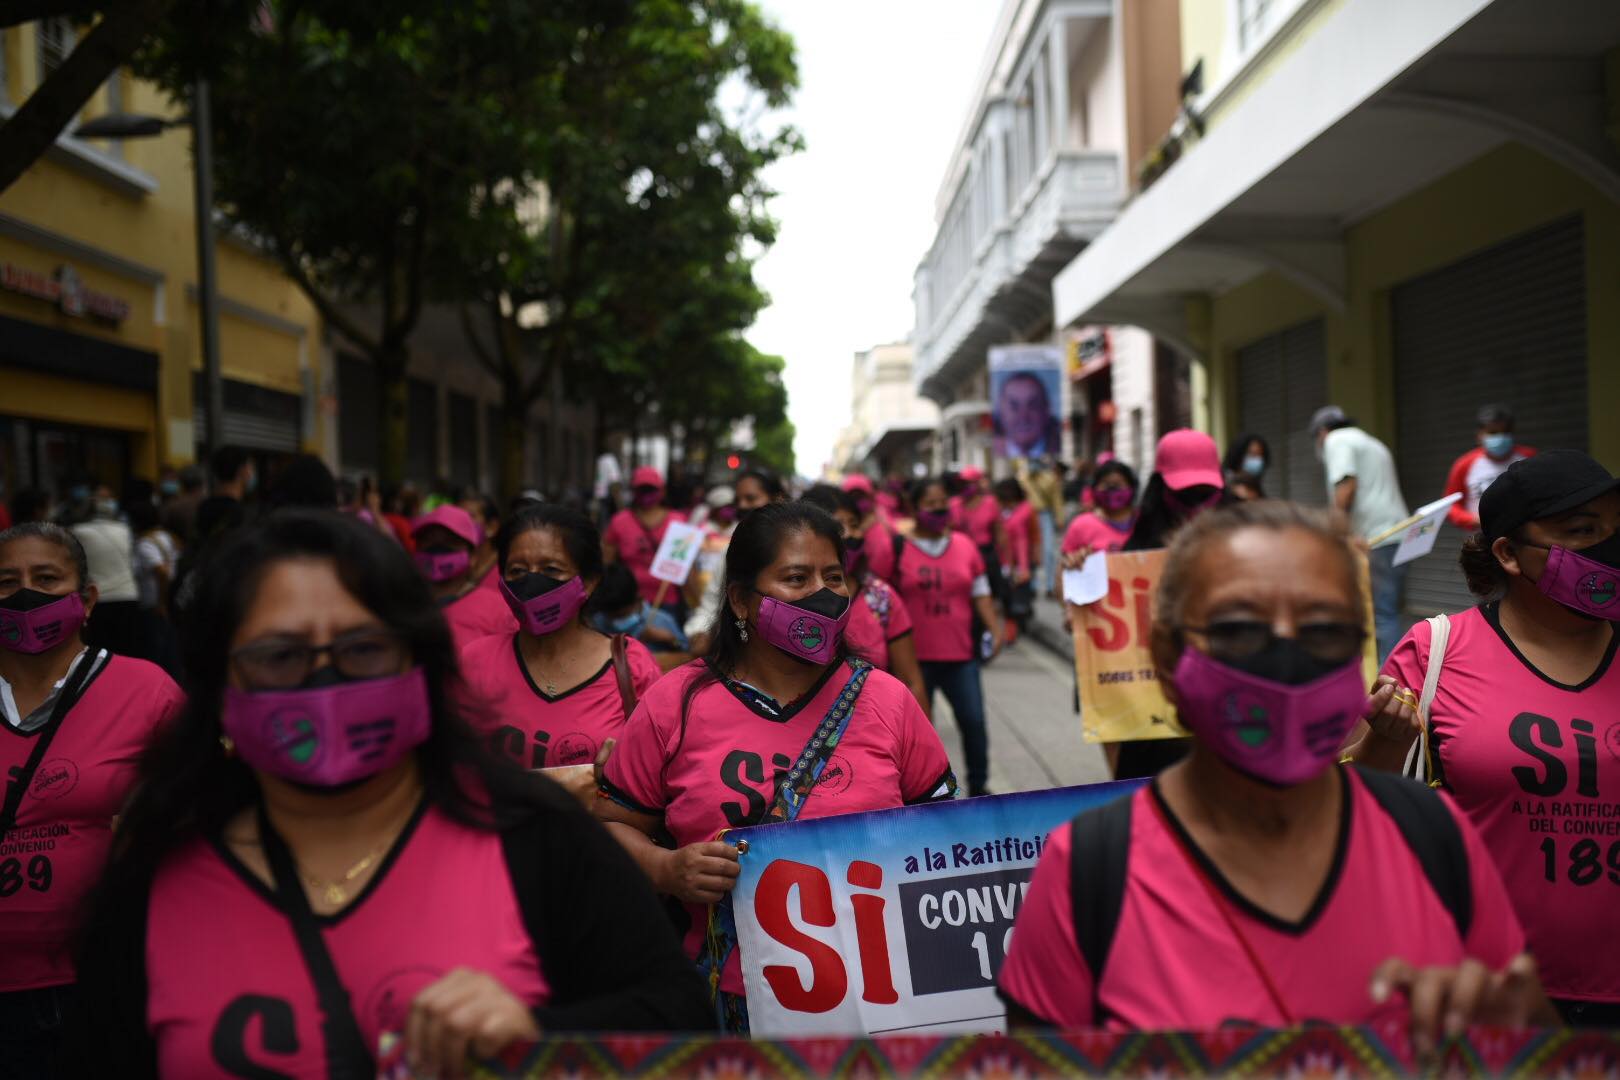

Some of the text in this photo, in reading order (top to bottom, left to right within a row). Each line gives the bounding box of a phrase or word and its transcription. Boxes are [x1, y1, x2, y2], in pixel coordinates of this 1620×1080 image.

[1088, 577, 1150, 653] Si
[1508, 711, 1599, 798] Si
[1511, 801, 1522, 814] A
[1527, 802, 1546, 816] LA
[1529, 819, 1558, 833] DEL
[904, 855, 919, 874] a
[924, 847, 947, 871] la
[754, 858, 899, 1014] Si
[971, 926, 1014, 980] 1
